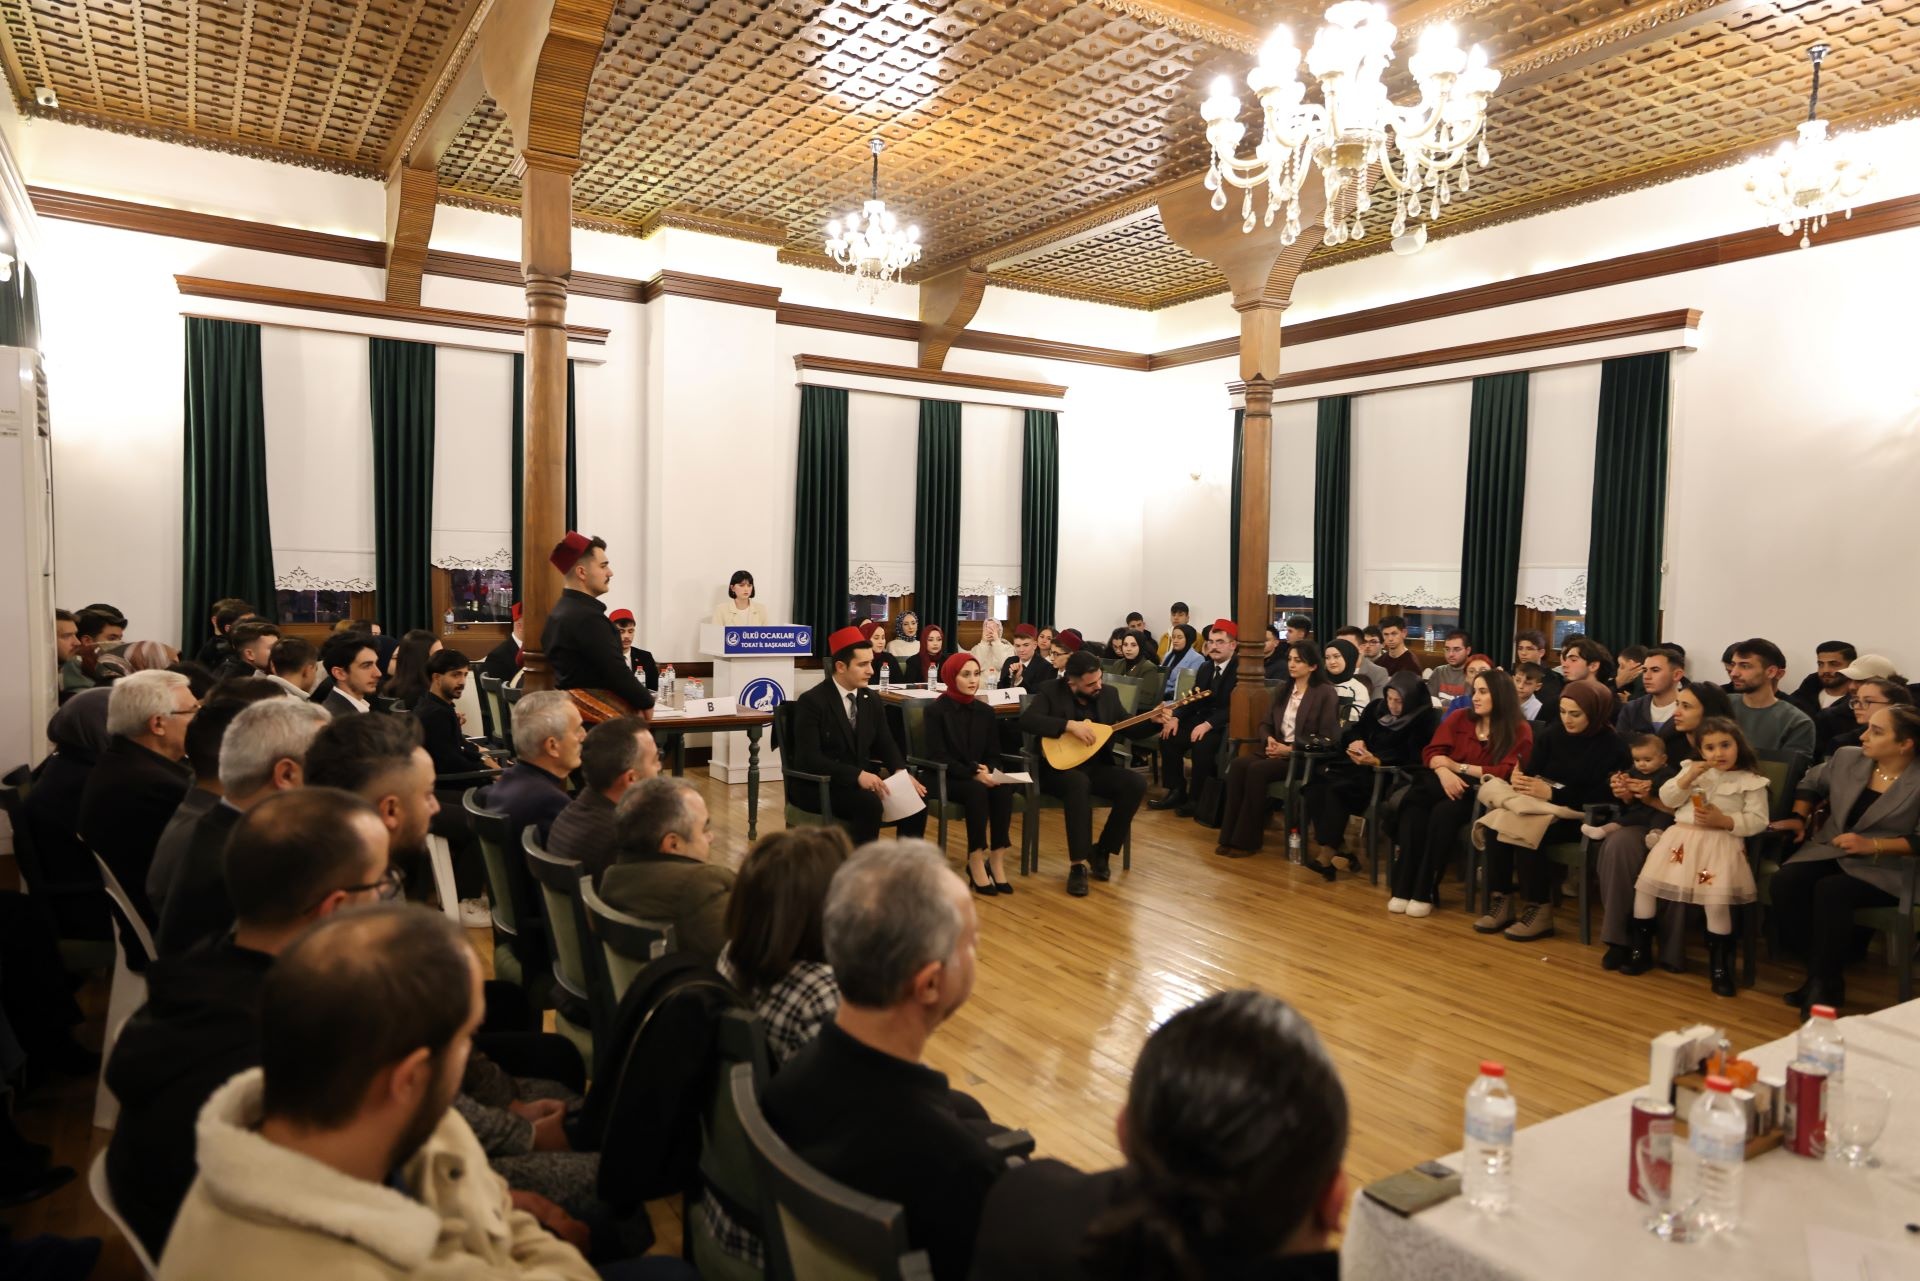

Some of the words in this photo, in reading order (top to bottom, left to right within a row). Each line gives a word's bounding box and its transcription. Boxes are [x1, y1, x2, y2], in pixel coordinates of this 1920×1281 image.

[743, 631, 759, 639] ÜLKÜ
[1004, 692, 1010, 700] A
[707, 701, 715, 712] B
